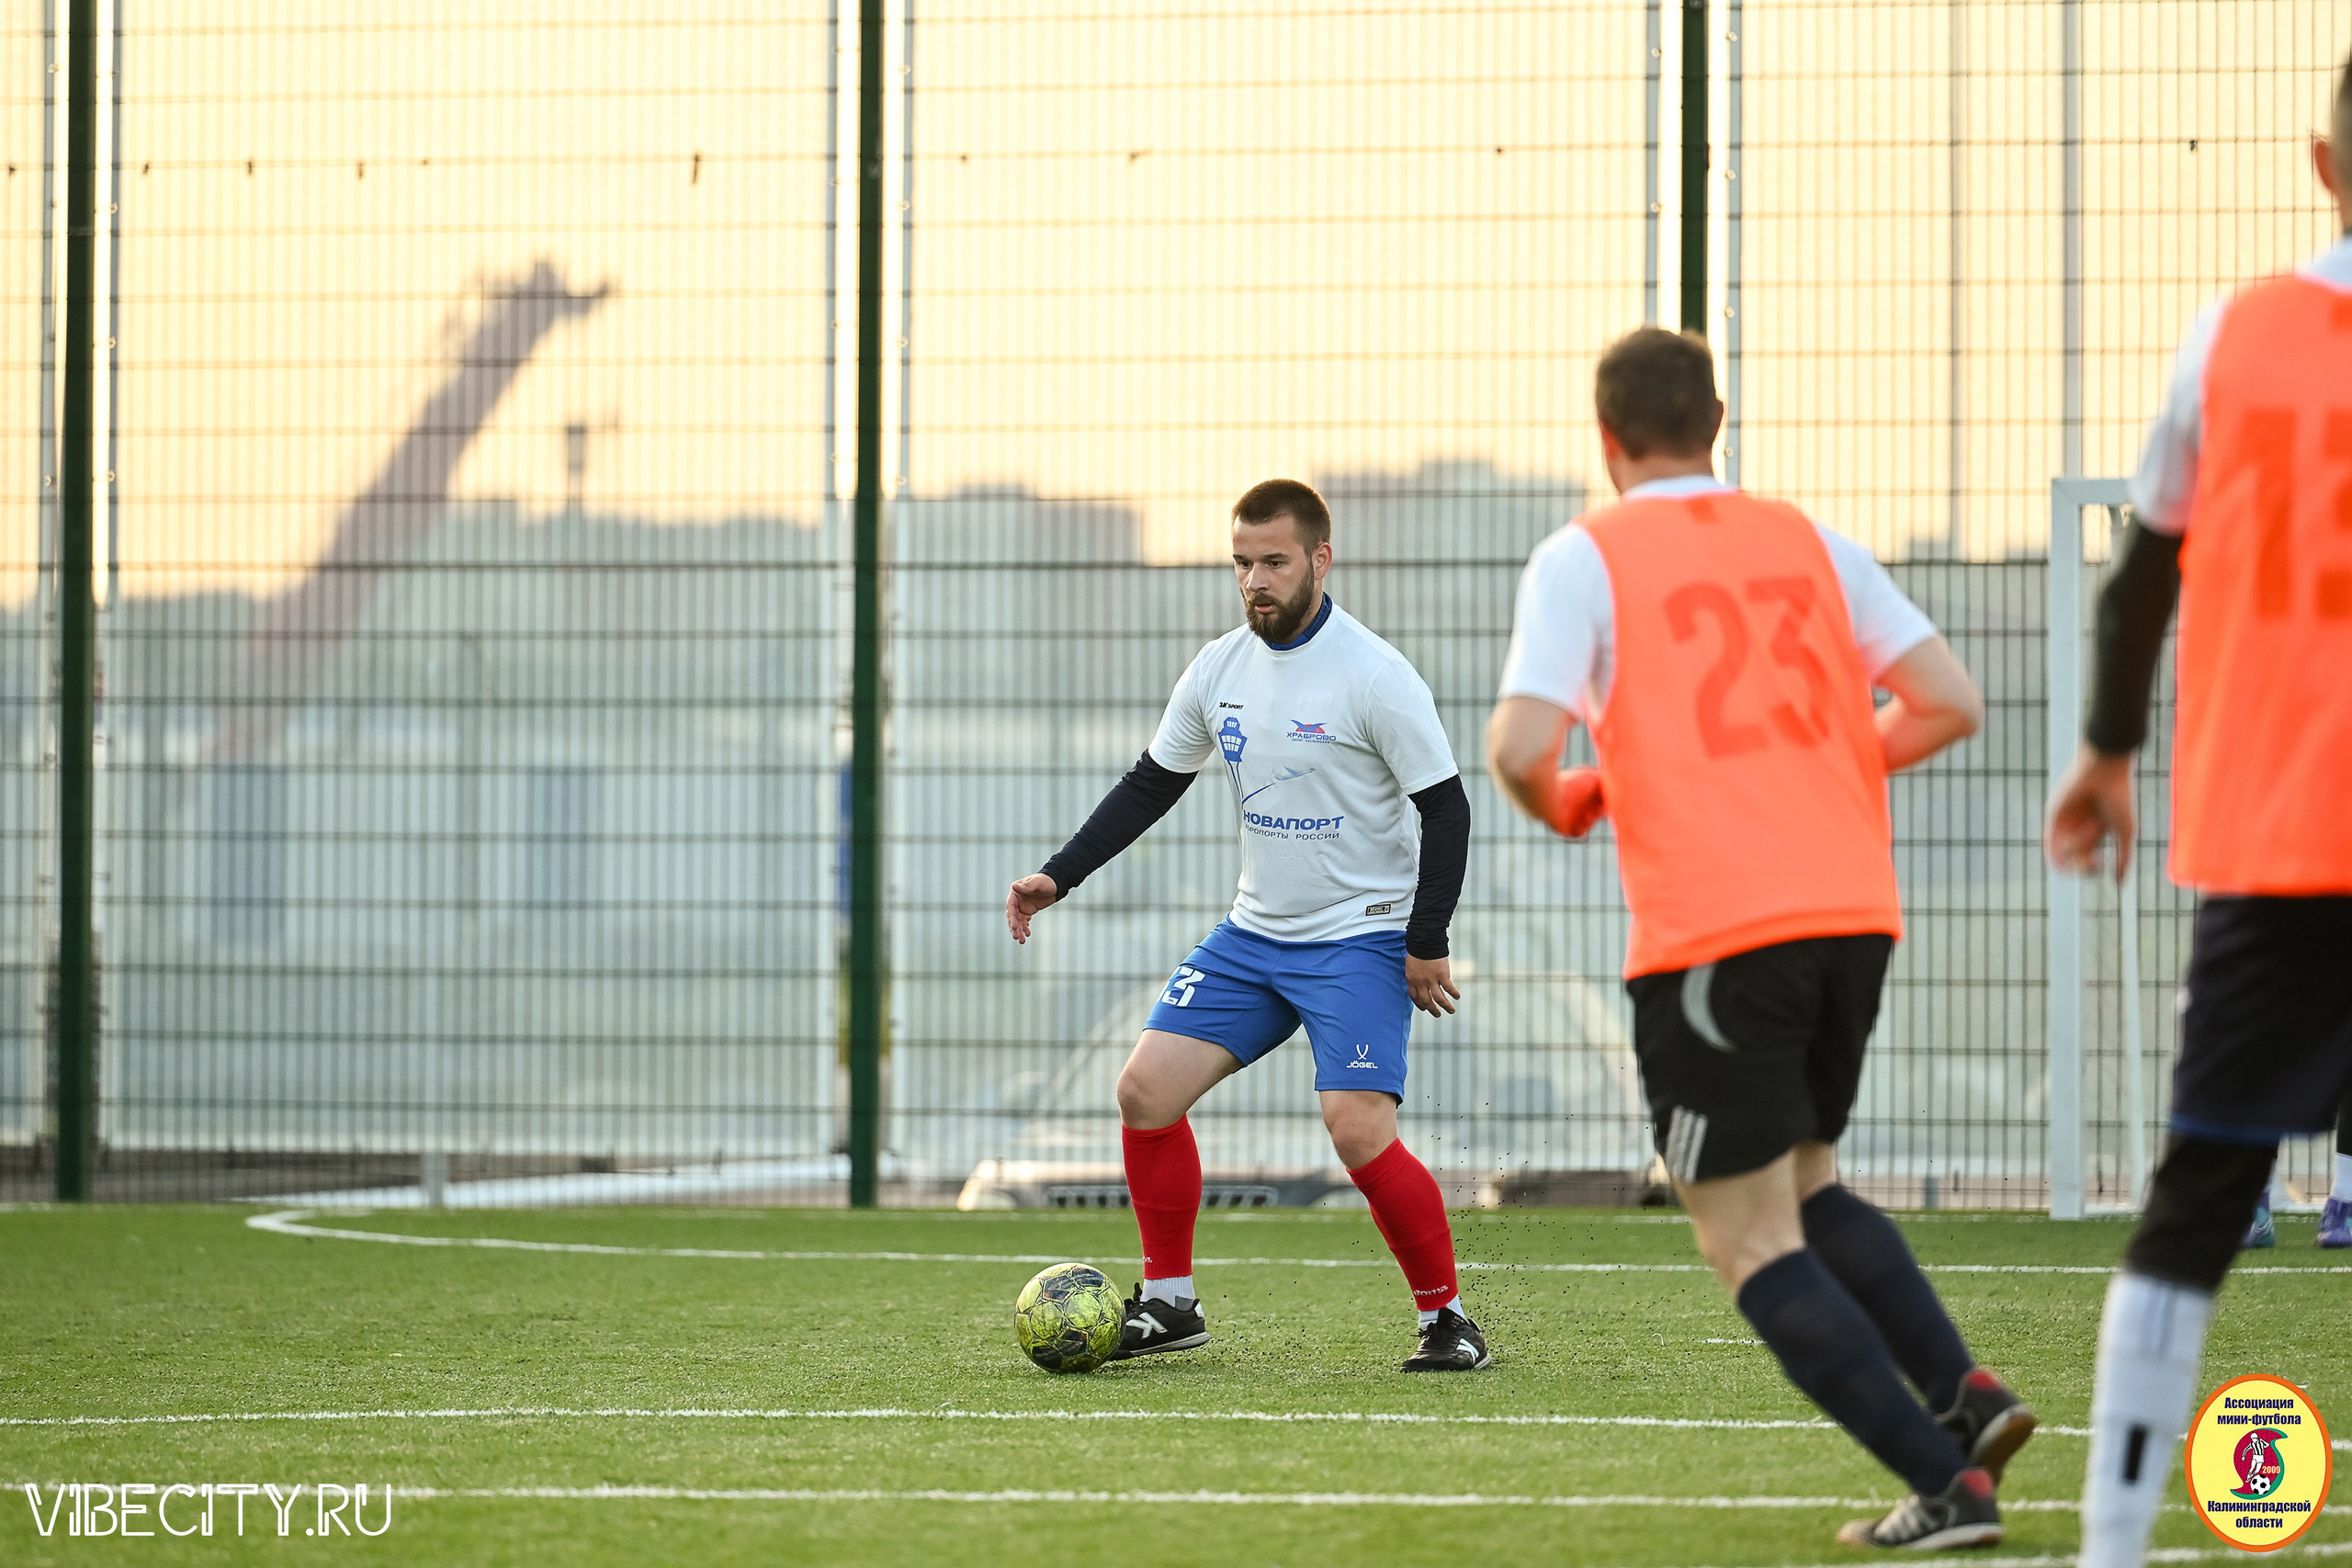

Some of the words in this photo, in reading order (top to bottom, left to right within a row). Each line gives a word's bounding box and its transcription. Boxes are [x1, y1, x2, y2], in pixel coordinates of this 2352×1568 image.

[1663, 576, 1831, 761] 23
[1286, 731, 1337, 741] ХРАБРОВО
[1243, 809, 1344, 830] НОВАПОРТ
[1346, 1060, 1378, 1069] JÖGEL
